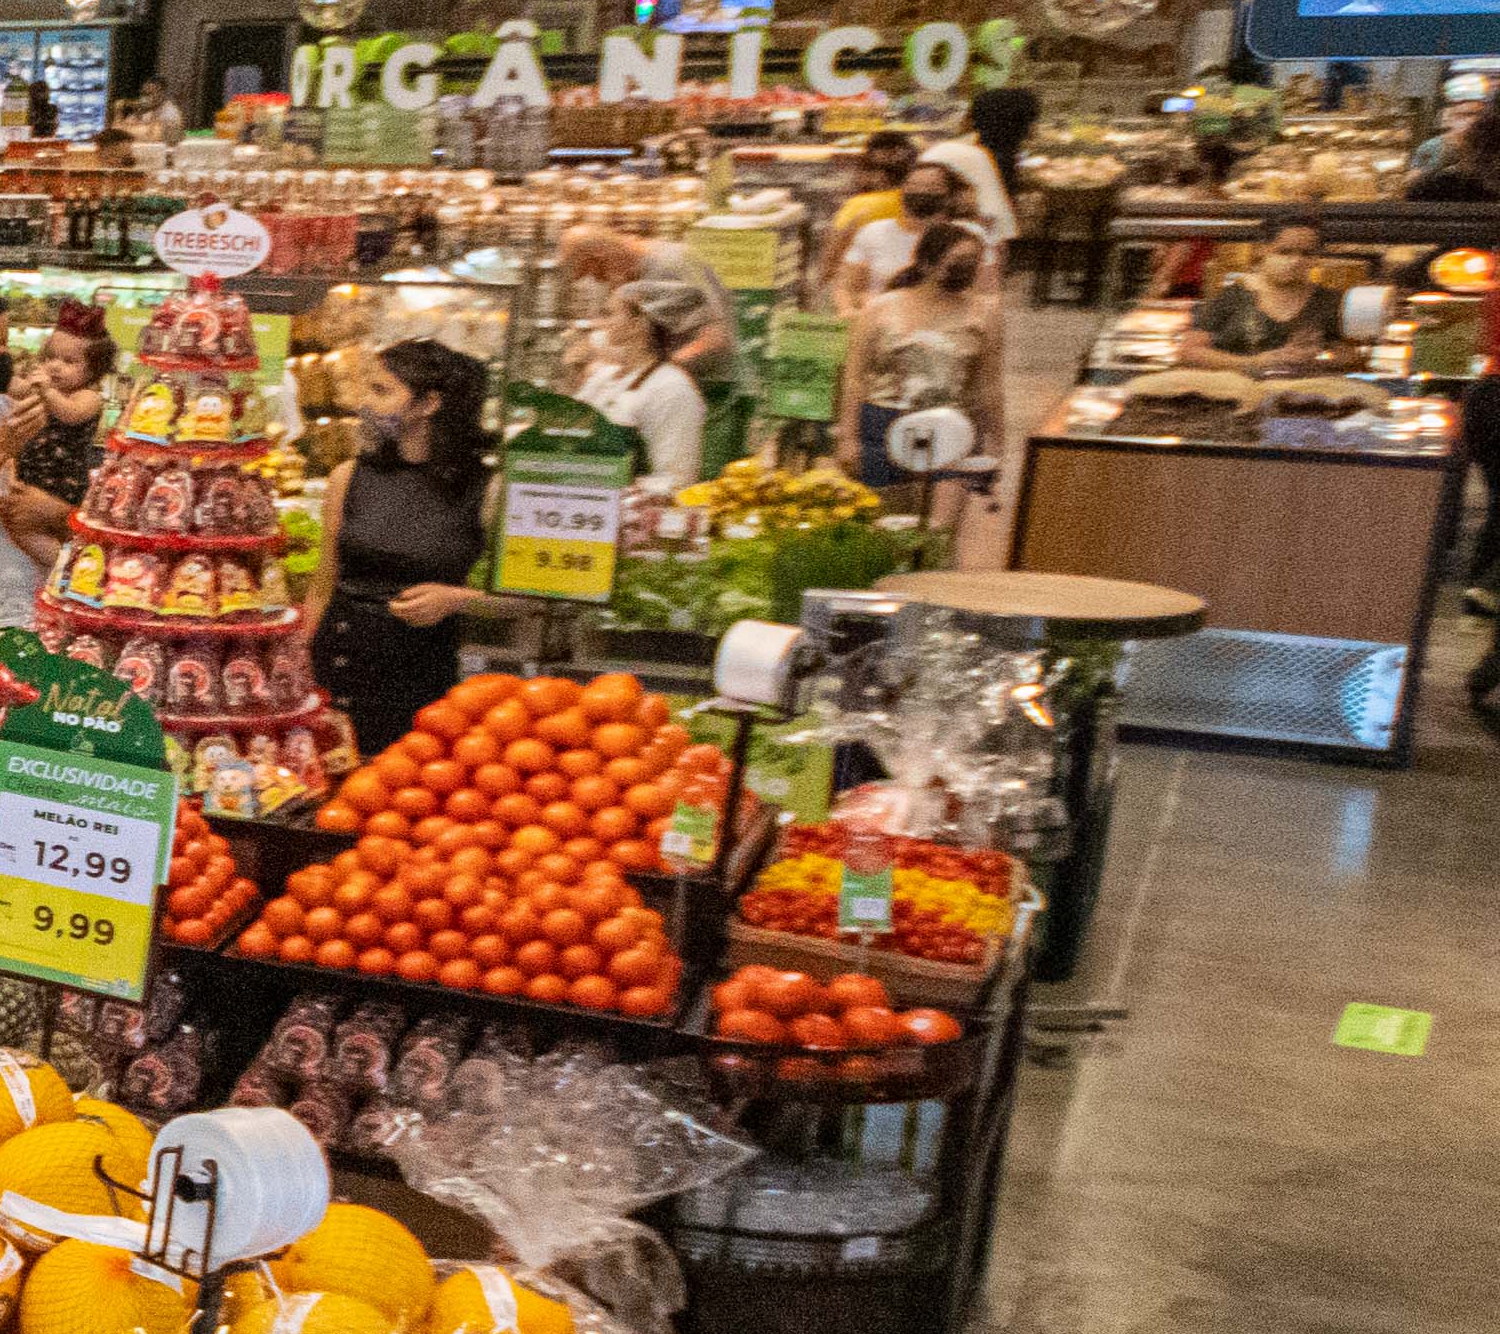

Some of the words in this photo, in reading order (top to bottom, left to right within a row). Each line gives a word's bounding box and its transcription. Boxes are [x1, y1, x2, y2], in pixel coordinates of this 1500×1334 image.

[163, 232, 261, 252] TREBESCHI
[43, 683, 133, 724] Natal
[53, 711, 80, 726] NO
[82, 715, 122, 734] PÃO
[6, 755, 160, 801] EXCLUSIVIDADE
[32, 810, 89, 829] MELÃO
[92, 823, 121, 836] REI
[33, 840, 133, 884] 12,99
[32, 905, 116, 946] 9,99
